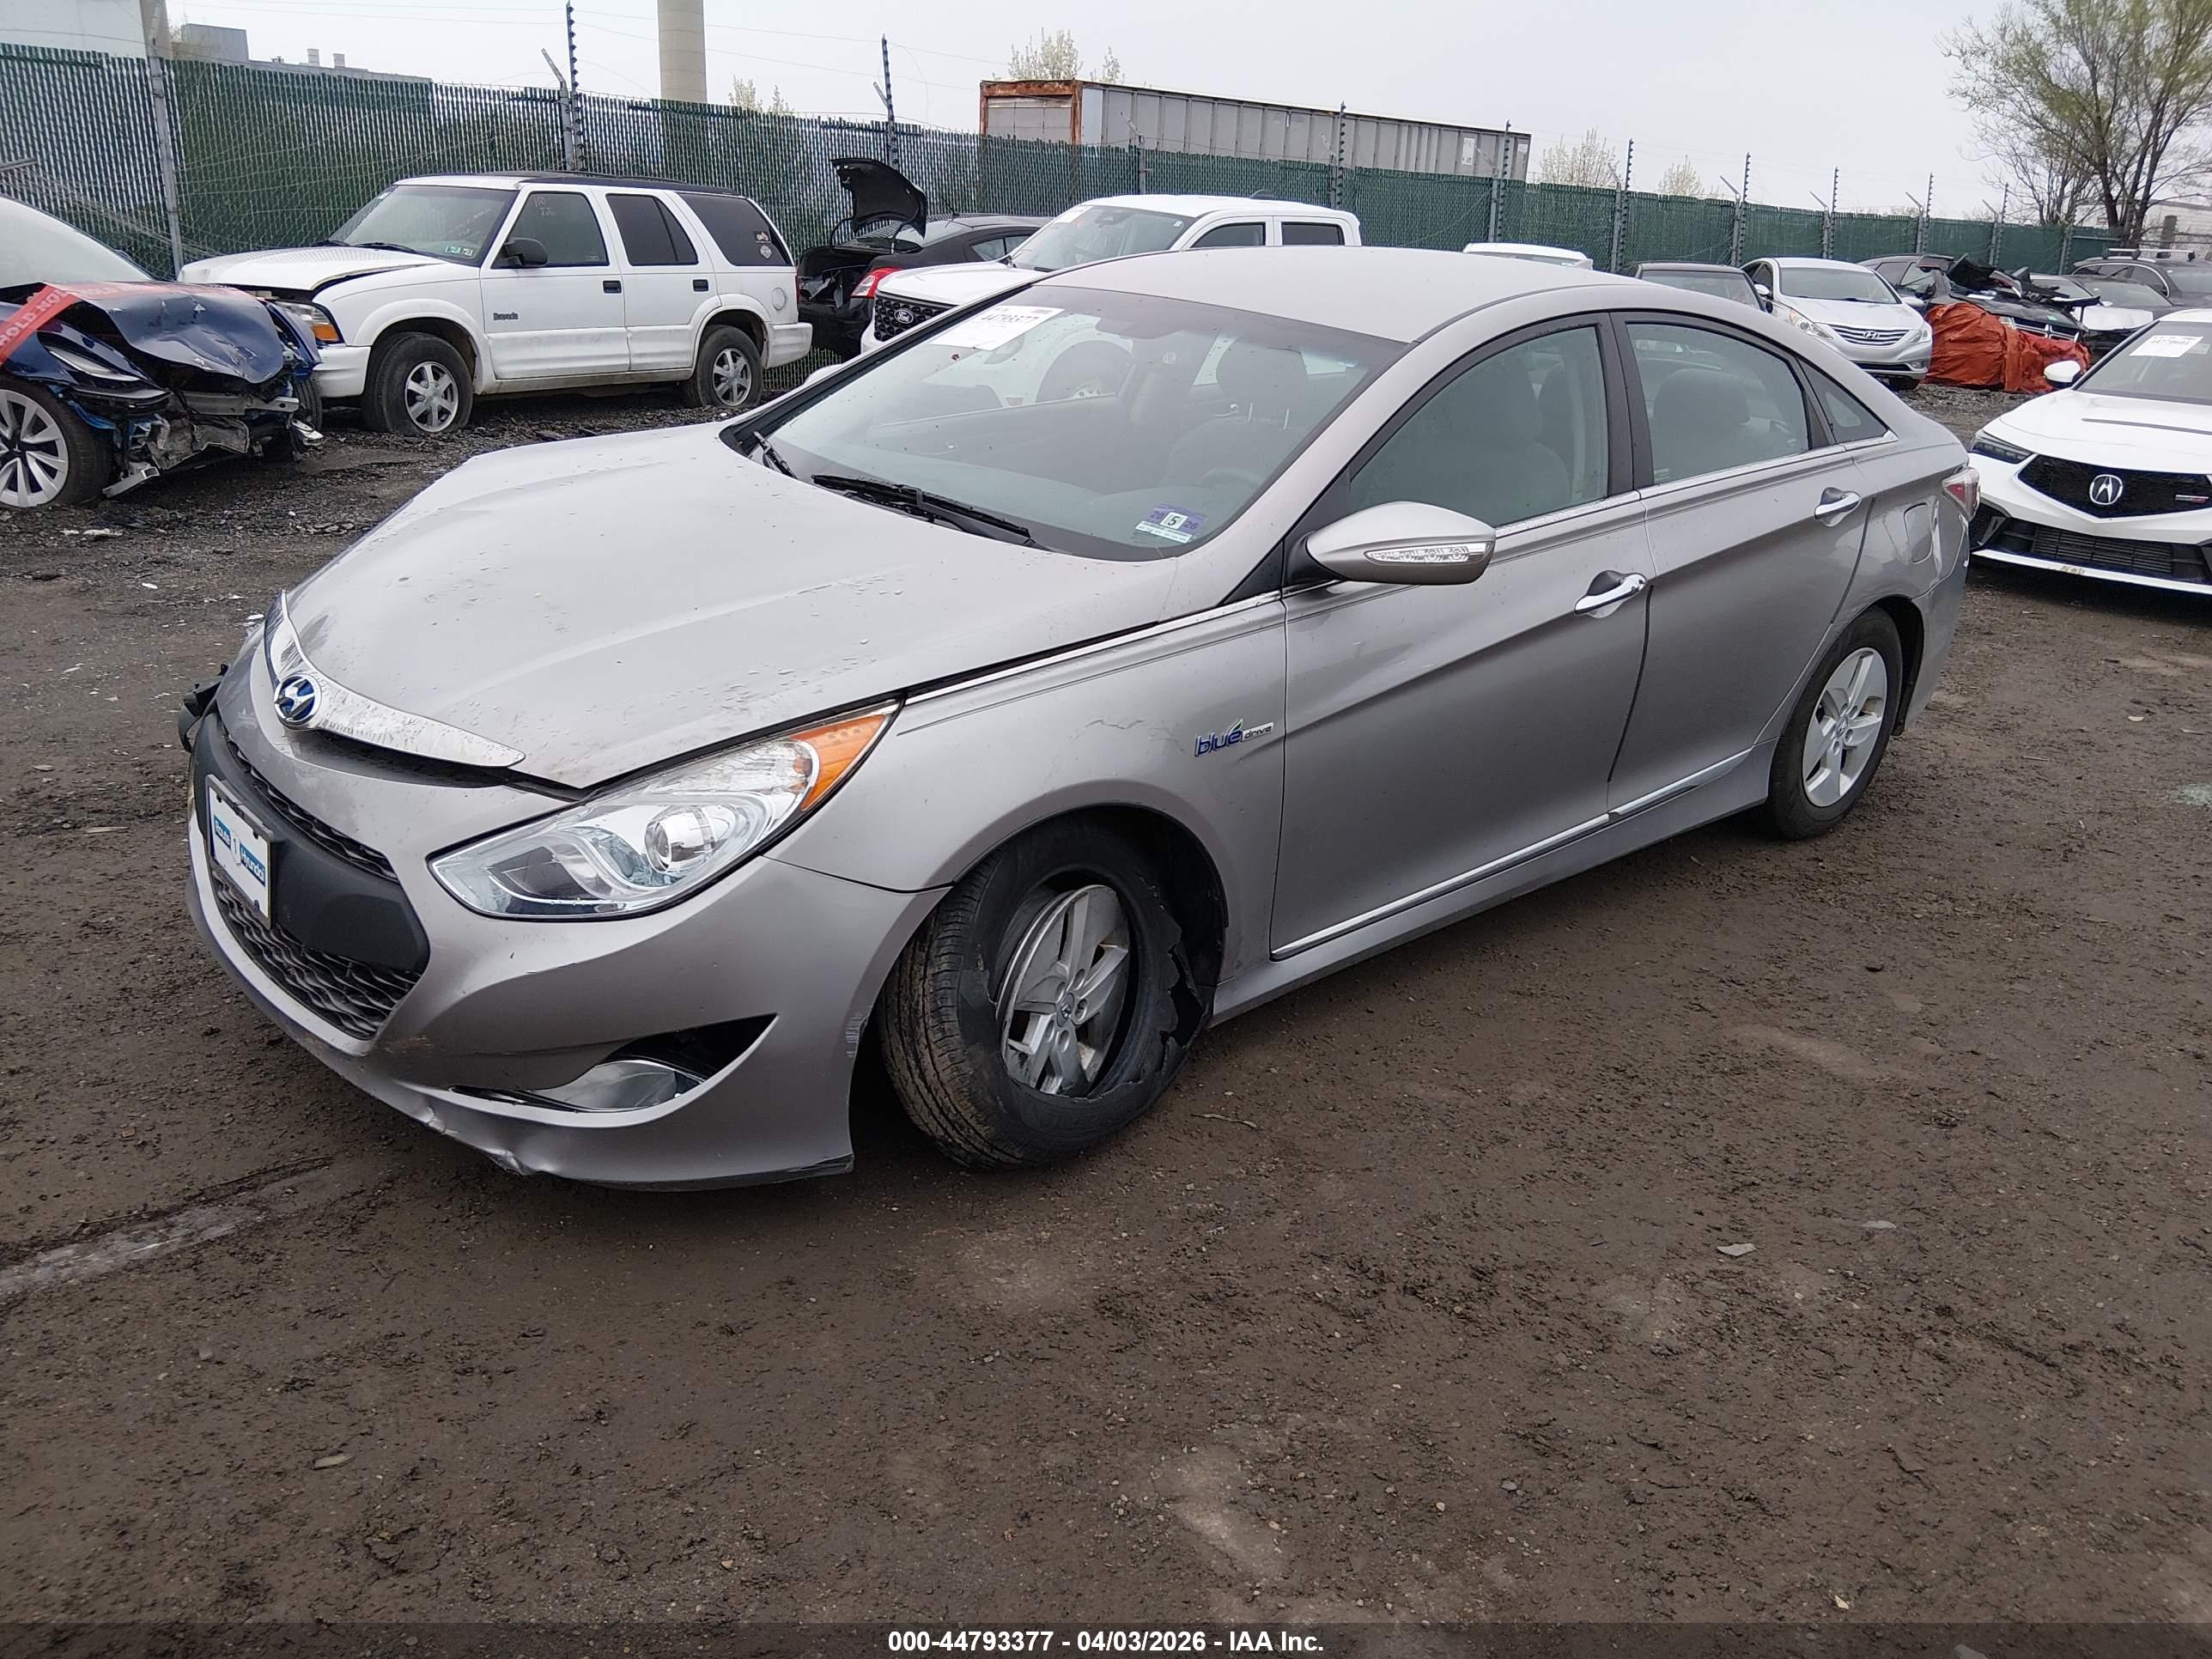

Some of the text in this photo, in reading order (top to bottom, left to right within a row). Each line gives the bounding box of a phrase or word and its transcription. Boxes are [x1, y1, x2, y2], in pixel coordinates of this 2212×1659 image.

[1168, 515, 1181, 526] 5
[1184, 520, 1200, 530] 26
[215, 817, 231, 848] Route
[240, 844, 265, 885] Hyundai
